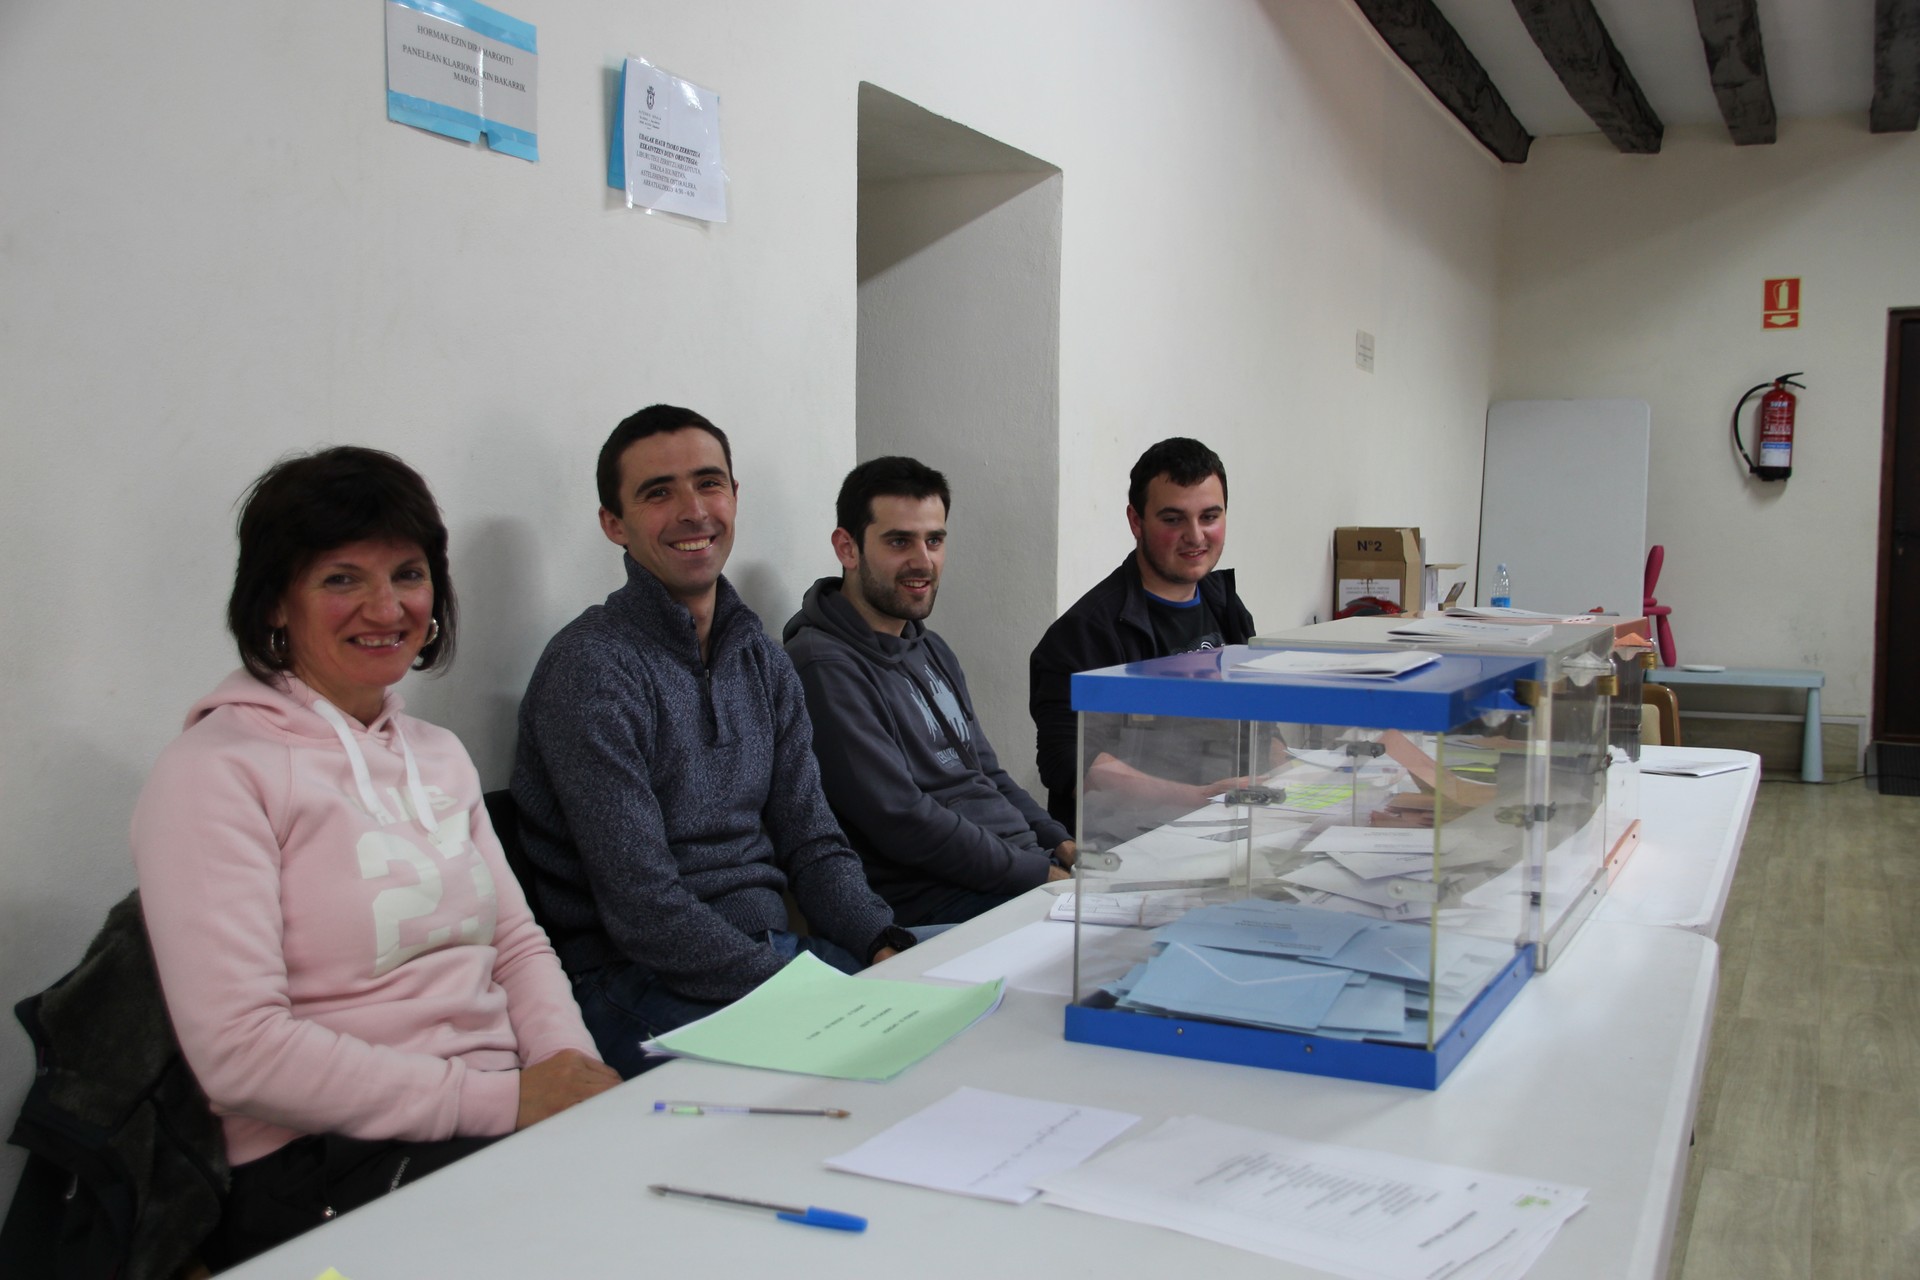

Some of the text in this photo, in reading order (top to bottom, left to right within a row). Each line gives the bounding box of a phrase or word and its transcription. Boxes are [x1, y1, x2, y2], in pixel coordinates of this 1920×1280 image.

[417, 25, 450, 43] HORMAK
[451, 36, 467, 49] EZIN
[483, 48, 514, 66] MARGOTU
[402, 45, 442, 64] PANELEAN
[494, 74, 526, 93] BAKARRIK
